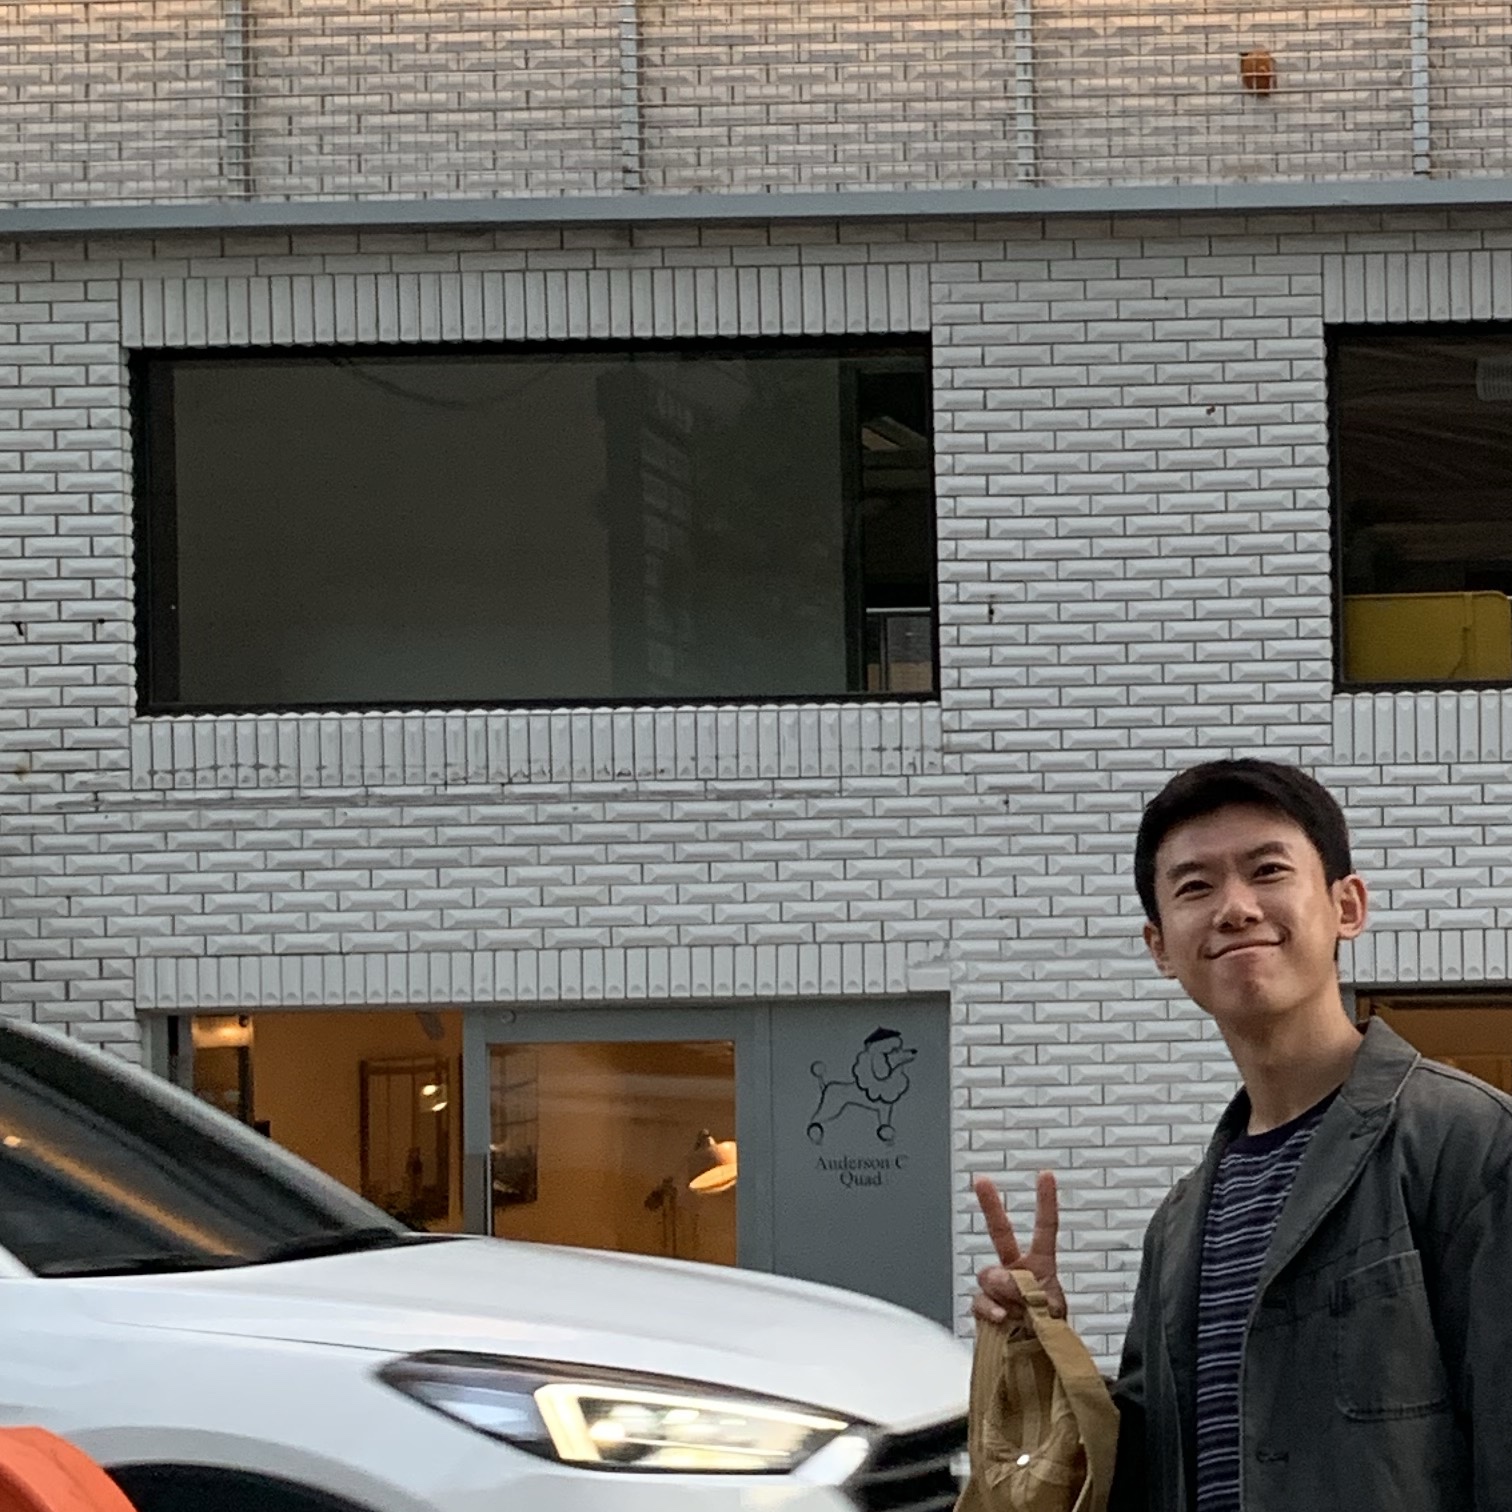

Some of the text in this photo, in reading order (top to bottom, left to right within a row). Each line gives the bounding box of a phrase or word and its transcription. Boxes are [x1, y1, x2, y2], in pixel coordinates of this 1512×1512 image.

[816, 1155, 908, 1170] Anderson C
[840, 1172, 882, 1188] Quad
